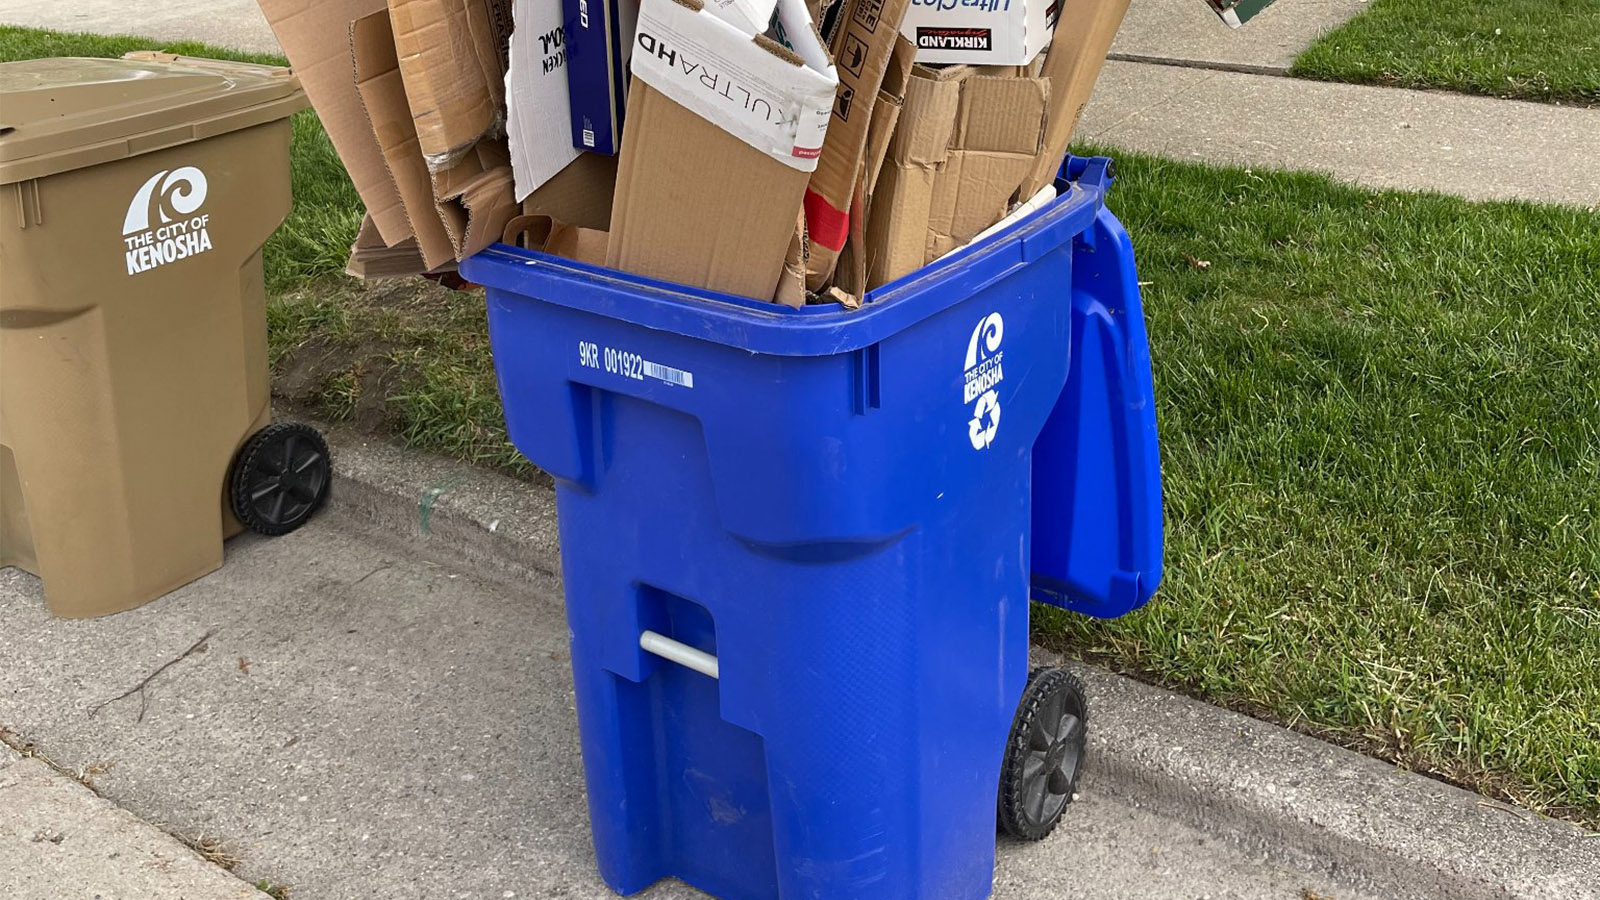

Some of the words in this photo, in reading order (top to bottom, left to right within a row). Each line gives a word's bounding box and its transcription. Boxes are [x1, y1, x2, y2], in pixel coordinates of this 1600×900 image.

[919, 36, 988, 48] KIRKLAND
[124, 231, 154, 250] THE
[156, 220, 188, 241] CITY
[190, 214, 209, 230] OF
[125, 228, 213, 275] KENOSHA
[579, 341, 600, 369] 9KR
[604, 347, 644, 380] 001922
[964, 367, 978, 384] THE
[979, 357, 994, 375] CITY
[994, 350, 1003, 363] OF
[964, 362, 1003, 404] KENOSHA
